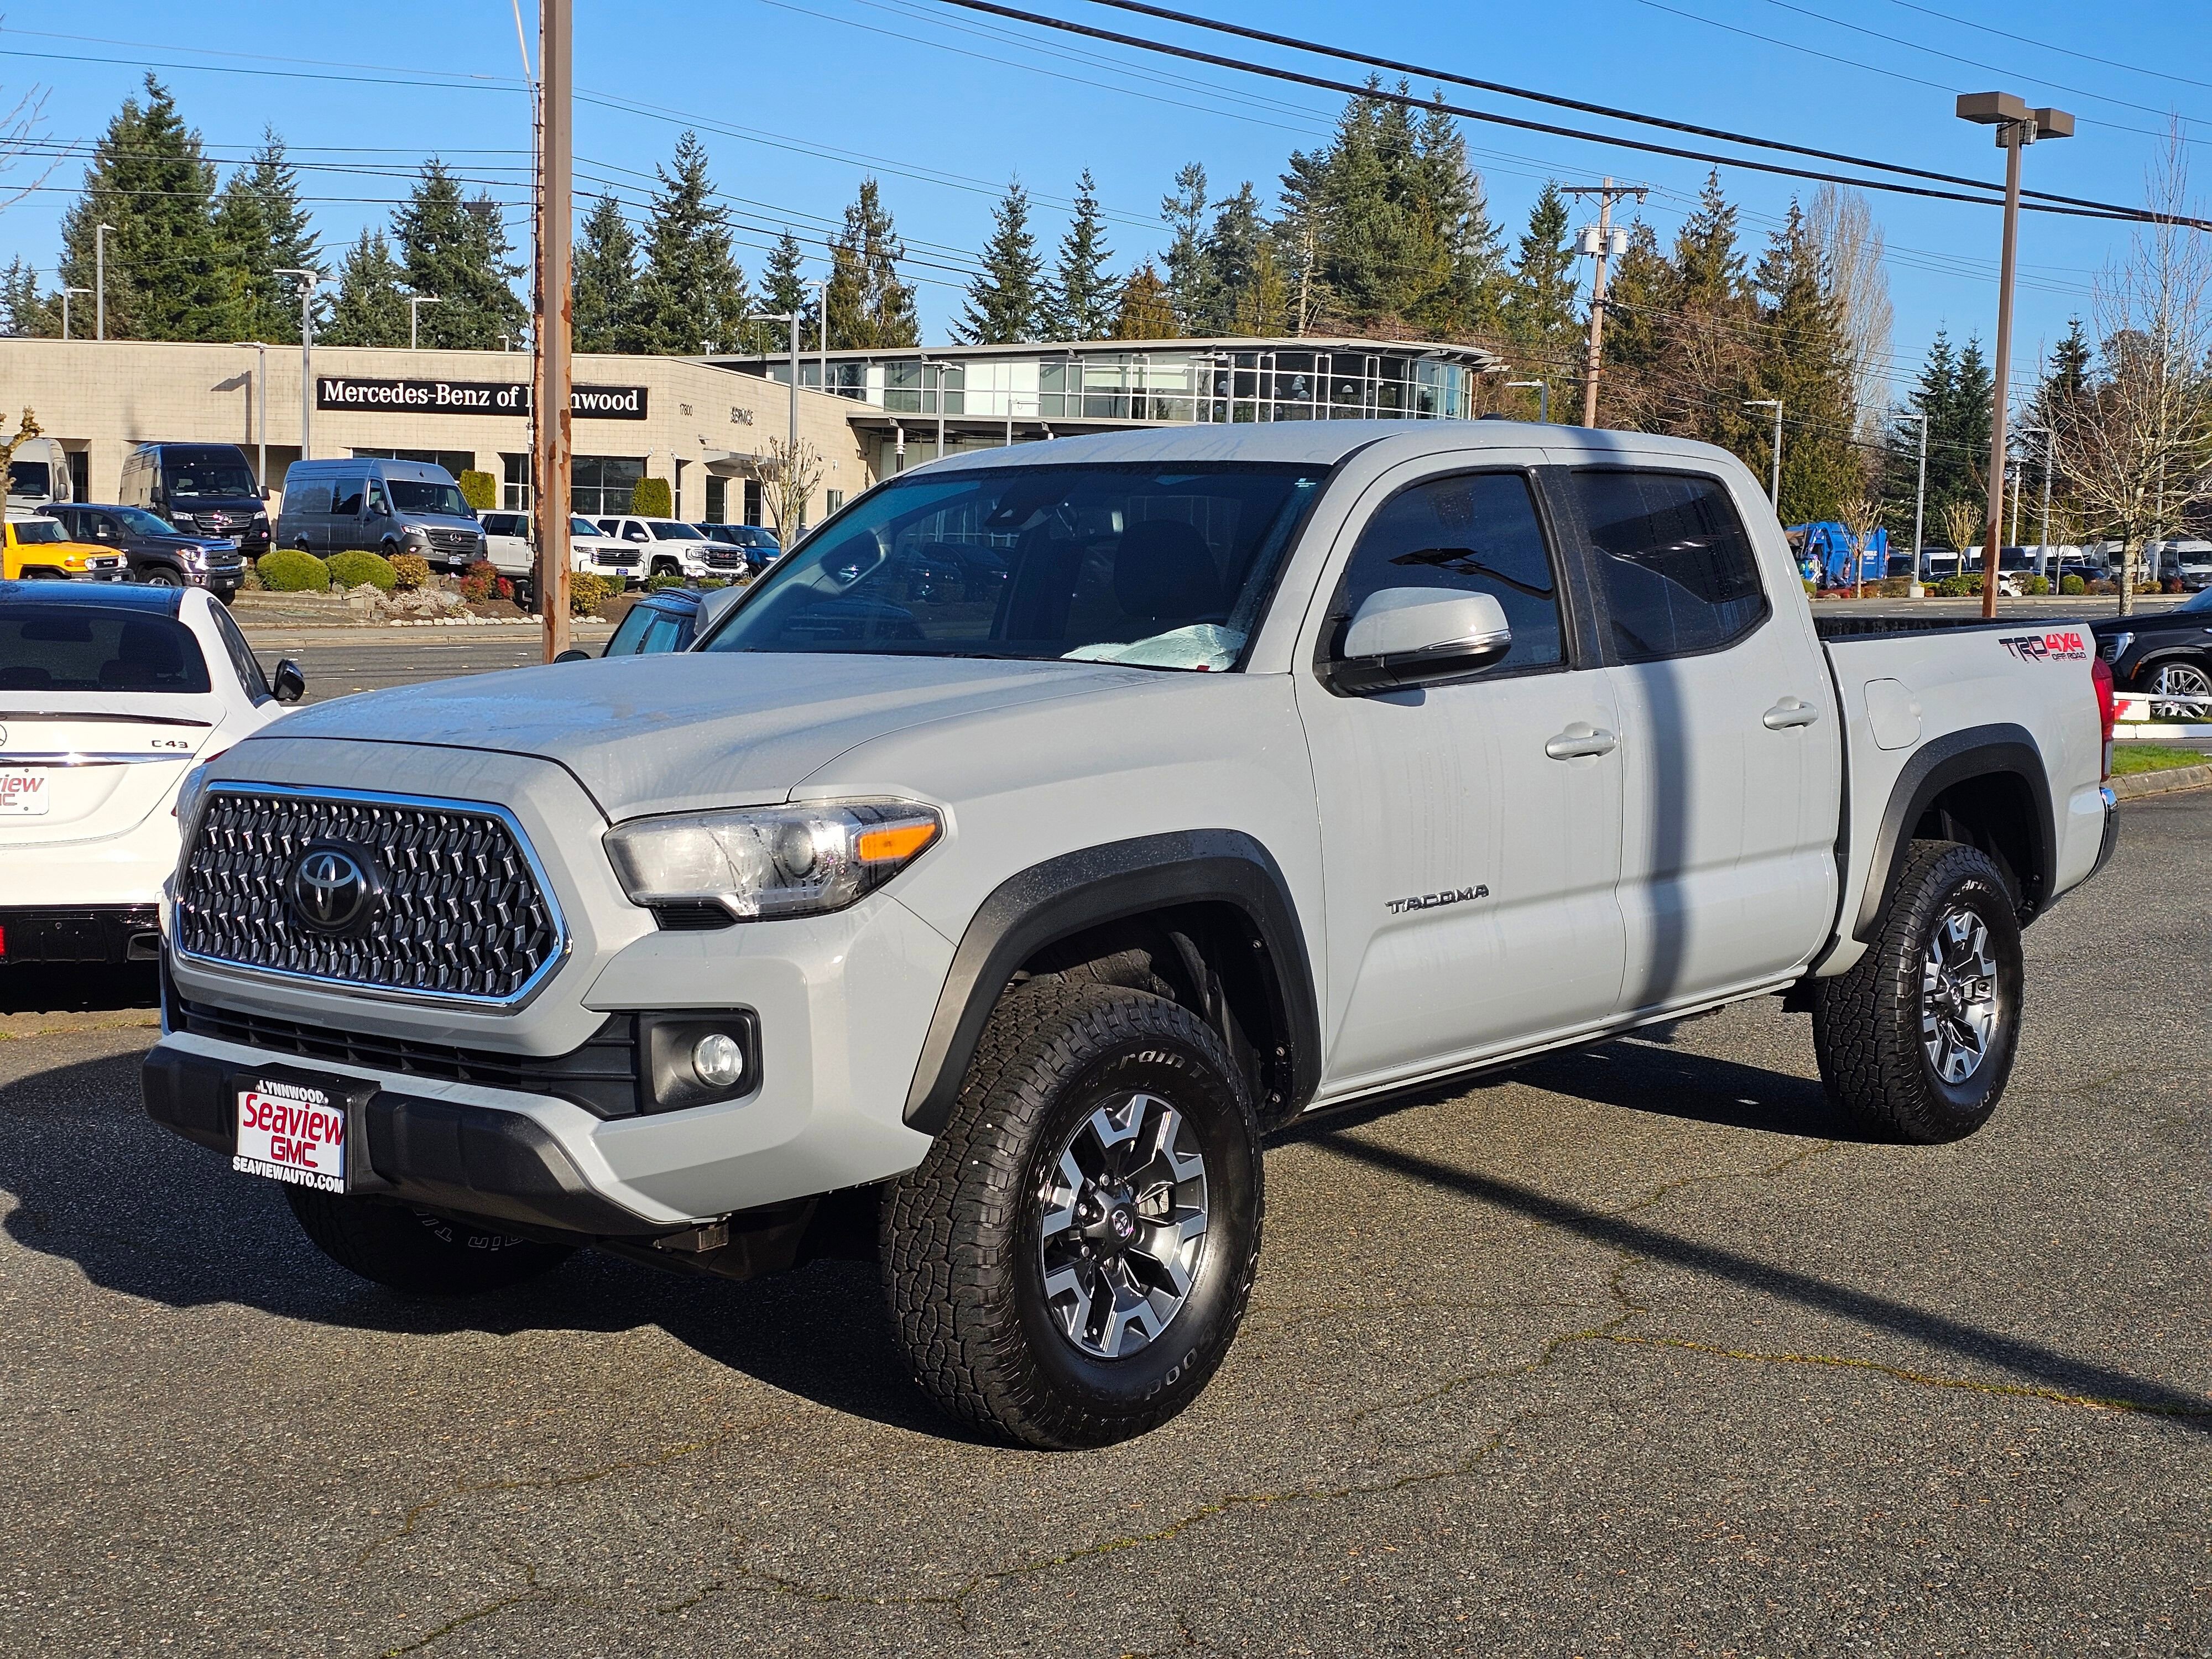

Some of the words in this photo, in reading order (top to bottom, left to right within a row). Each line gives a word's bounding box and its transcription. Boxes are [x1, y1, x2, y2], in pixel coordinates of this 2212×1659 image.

[323, 380, 491, 406] Mercedes-Benz
[497, 386, 520, 408] of
[525, 386, 639, 411] nwood
[679, 403, 693, 416] 17800
[730, 406, 754, 426] SERVICE
[1998, 635, 2049, 664] TRD
[2052, 653, 2067, 662] OFF
[2067, 652, 2088, 661] ROAD
[1384, 884, 1489, 915] TACOMA
[259, 1079, 325, 1104] LYNNWOOD
[243, 1093, 345, 1146] Seaview
[270, 1135, 319, 1168] GMC
[232, 1156, 345, 1194] SEAVIEWAUTO.COM
